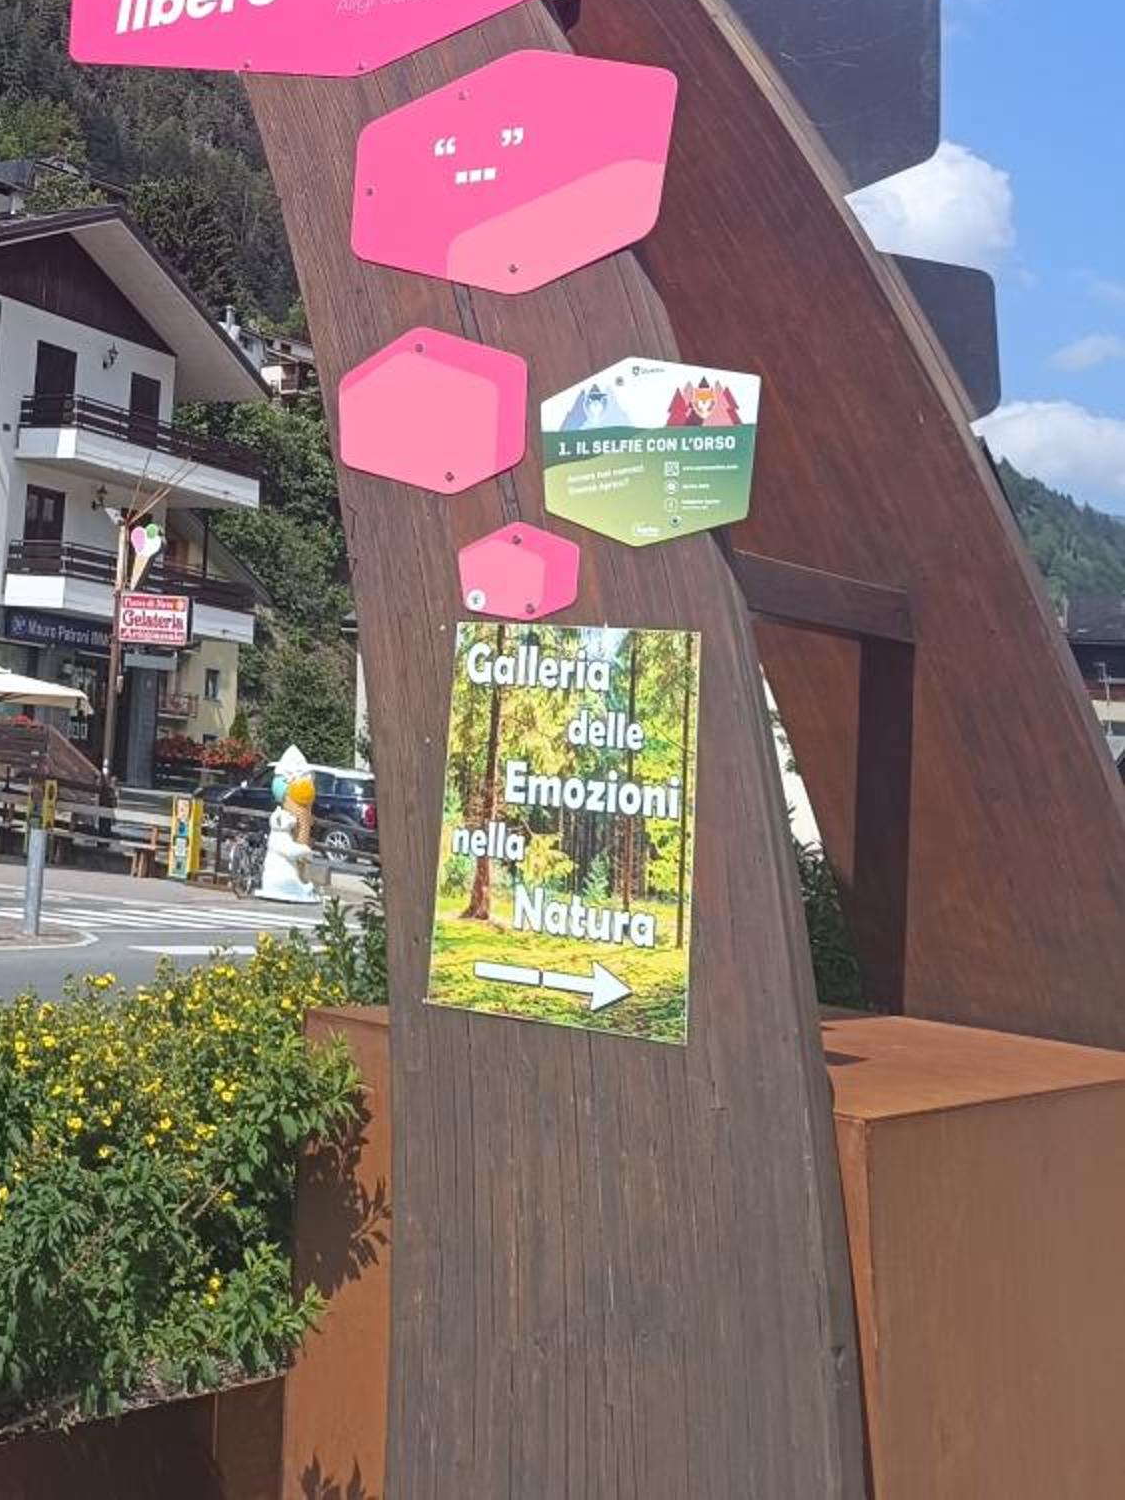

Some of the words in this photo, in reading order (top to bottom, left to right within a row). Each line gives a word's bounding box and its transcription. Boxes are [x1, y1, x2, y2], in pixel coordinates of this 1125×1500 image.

[558, 441, 572, 456] 1.
[576, 442, 590, 456] IL
[593, 439, 642, 454] SELFIE
[647, 437, 678, 452] CON
[682, 435, 736, 451] L'ORSO
[123, 610, 184, 631] Gelateria
[466, 642, 611, 692] Galleria
[567, 710, 645, 751] delle
[505, 760, 681, 819] Emozioni
[452, 821, 526, 861] nella
[512, 886, 656, 948] Natura
